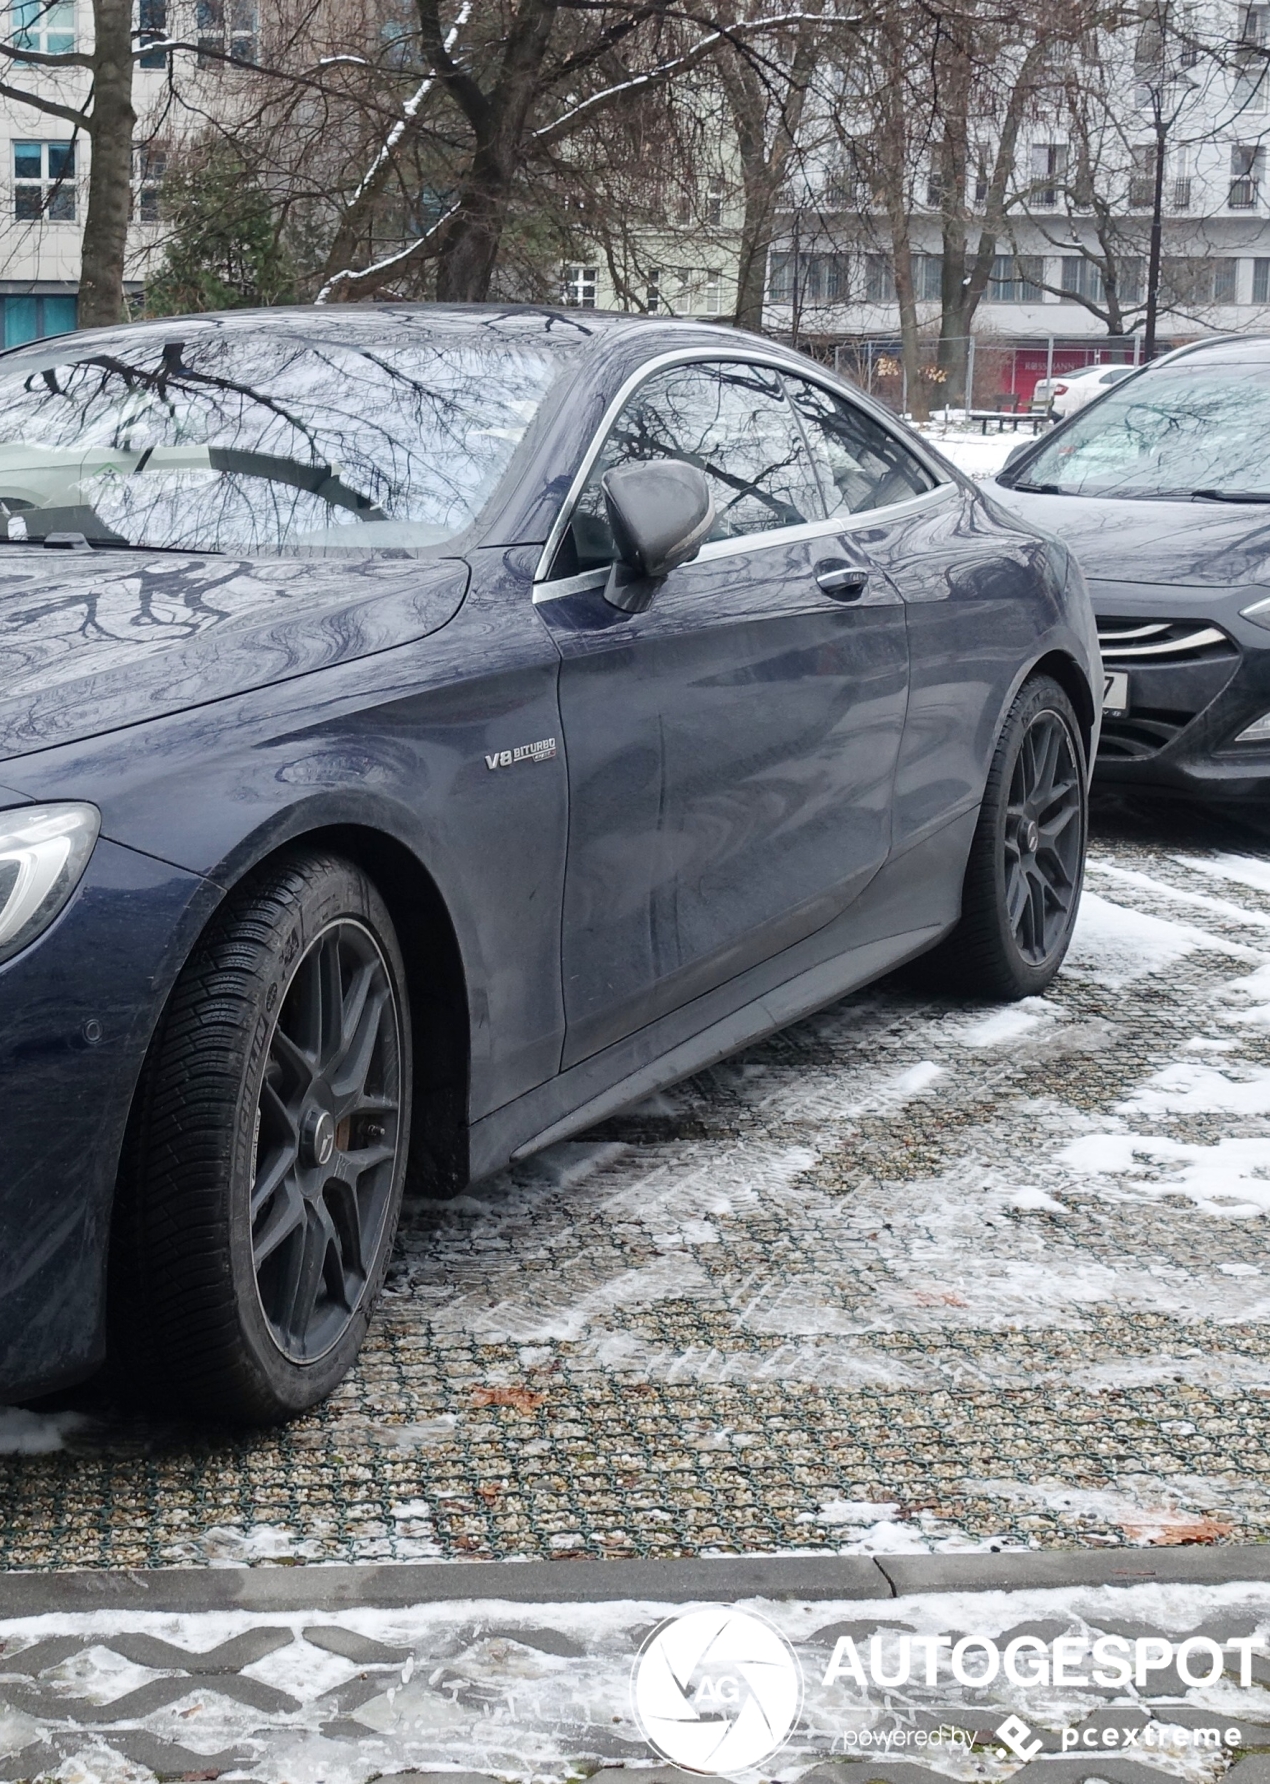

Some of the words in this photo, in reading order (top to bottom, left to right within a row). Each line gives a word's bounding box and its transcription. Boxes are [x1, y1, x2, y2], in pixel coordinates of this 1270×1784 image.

[1025, 361, 1075, 370] ROSSANN
[485, 750, 512, 769] V8
[514, 738, 555, 758] BITURBO
